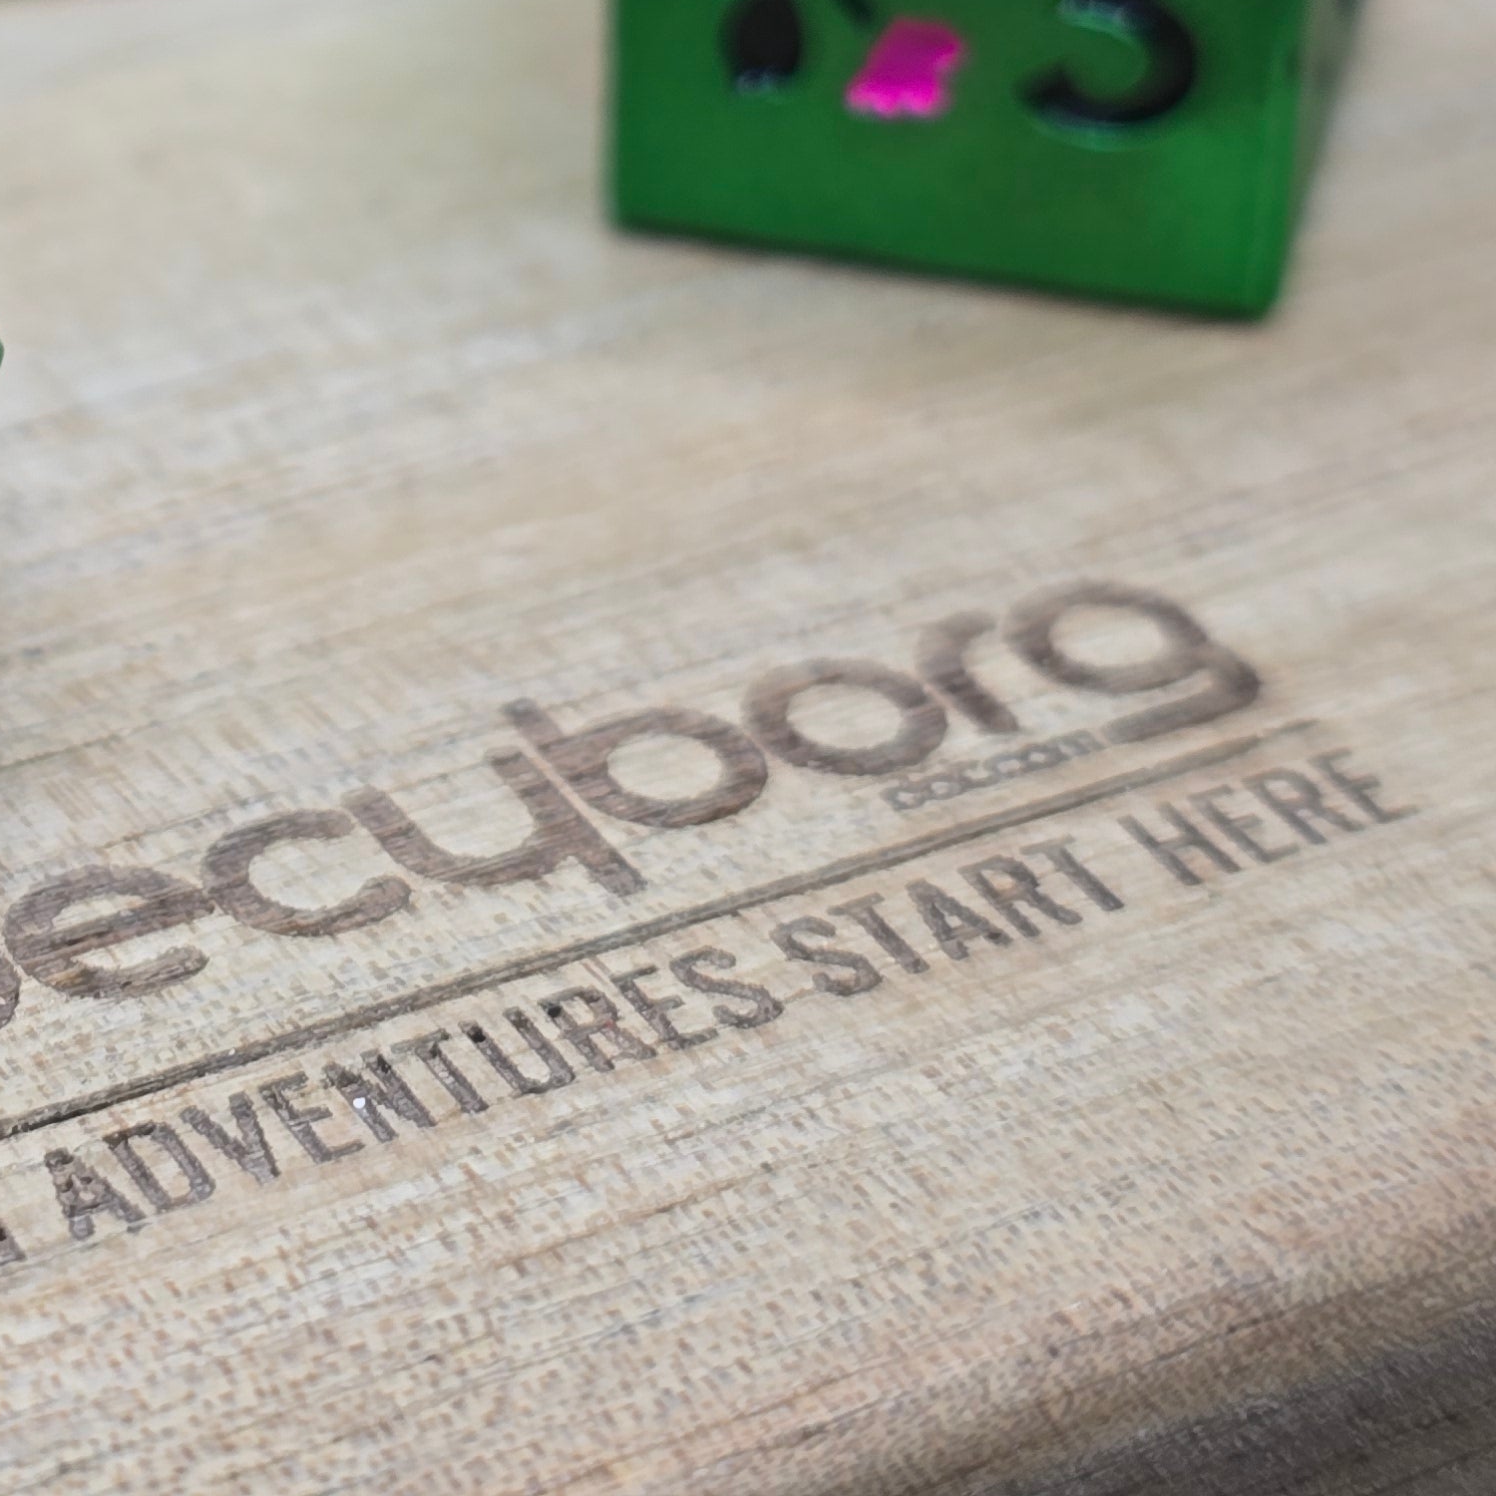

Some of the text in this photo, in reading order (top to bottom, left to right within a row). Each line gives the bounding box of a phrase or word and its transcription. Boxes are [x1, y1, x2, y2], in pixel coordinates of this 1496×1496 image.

[42, 946, 784, 1242] ADVENTURES
[770, 833, 1127, 998] START
[1117, 745, 1419, 888] HERE
